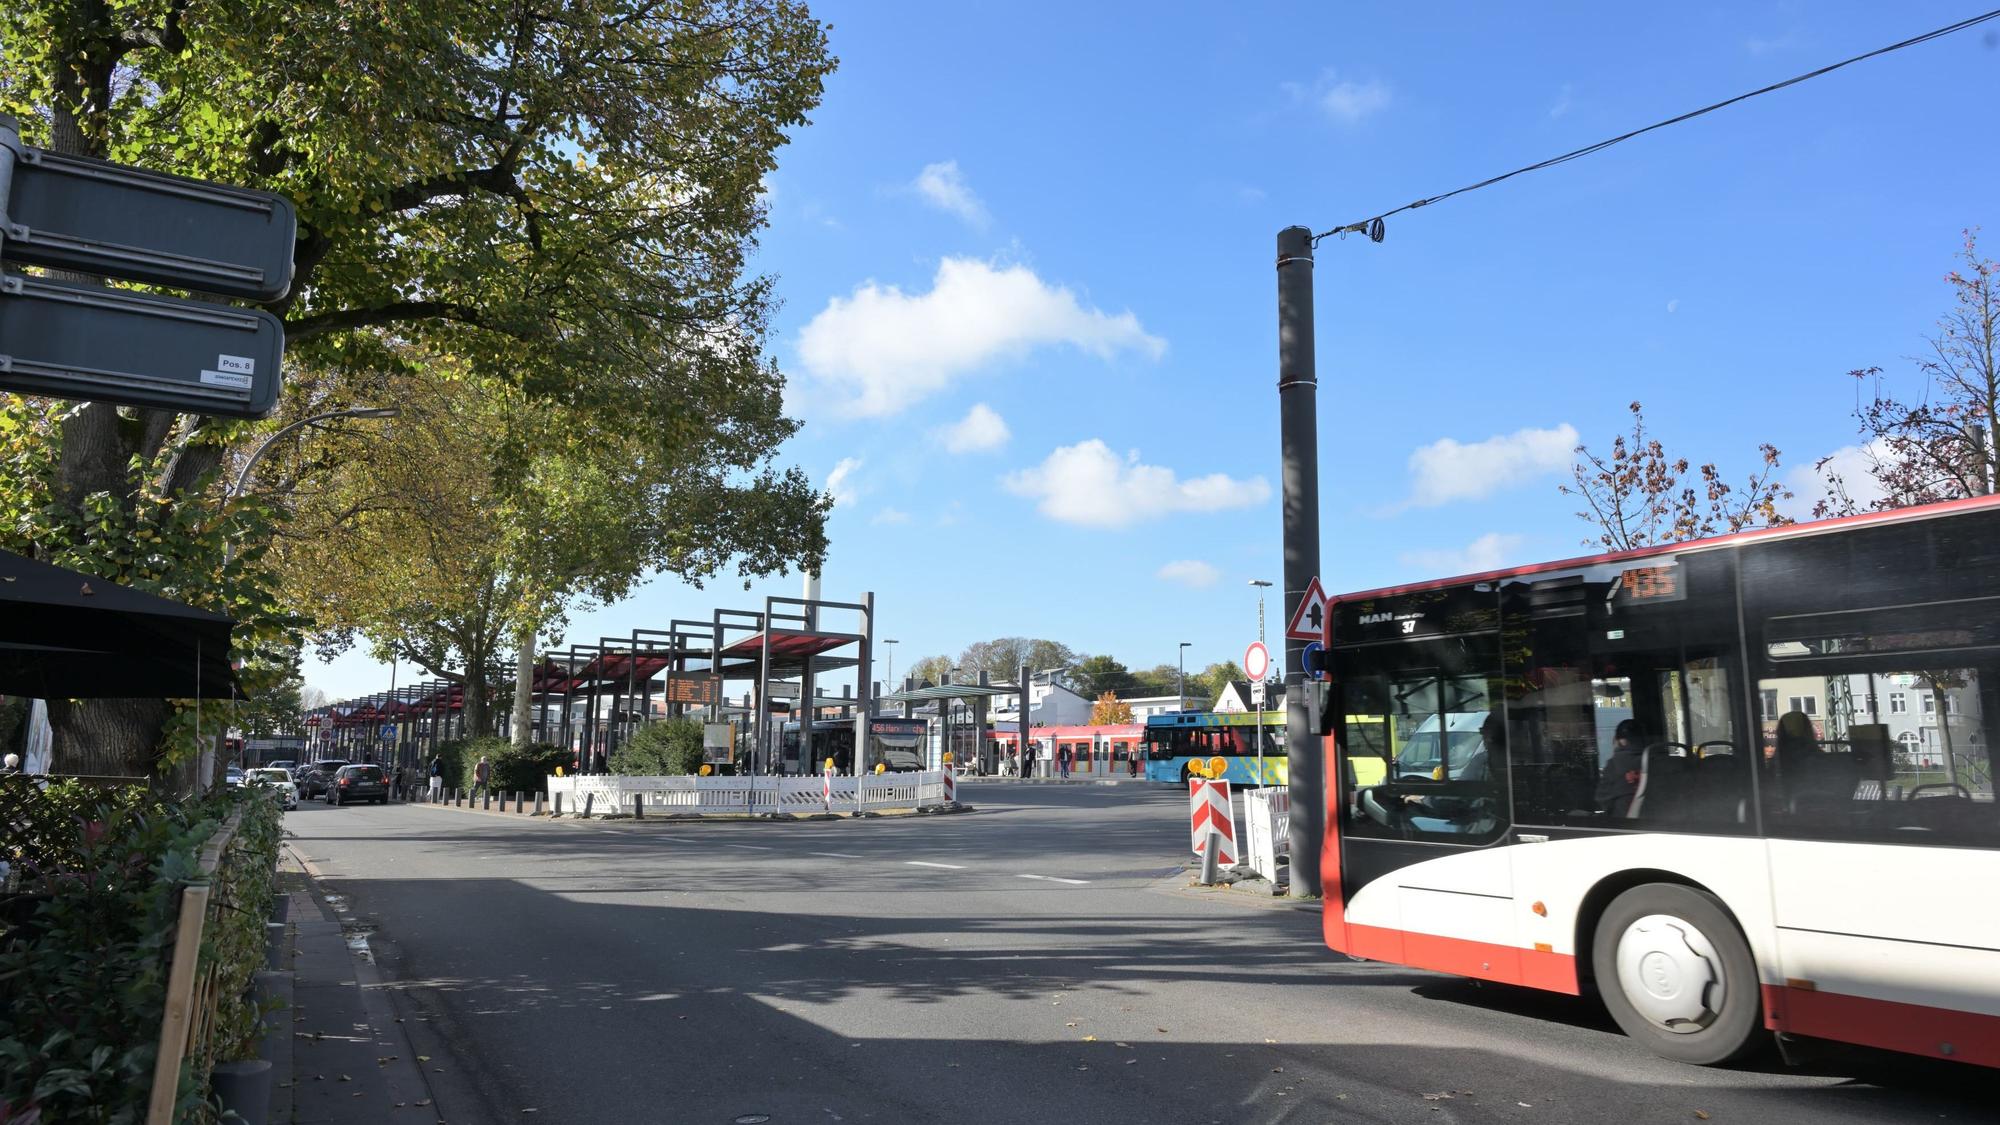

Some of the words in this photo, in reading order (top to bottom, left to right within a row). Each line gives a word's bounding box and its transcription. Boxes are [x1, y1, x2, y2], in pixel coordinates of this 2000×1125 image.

[223, 359, 242, 369] Pos.
[244, 362, 250, 370] 8
[1622, 566, 1675, 597] 435
[1359, 611, 1393, 625] MAN
[1402, 620, 1415, 633] 37
